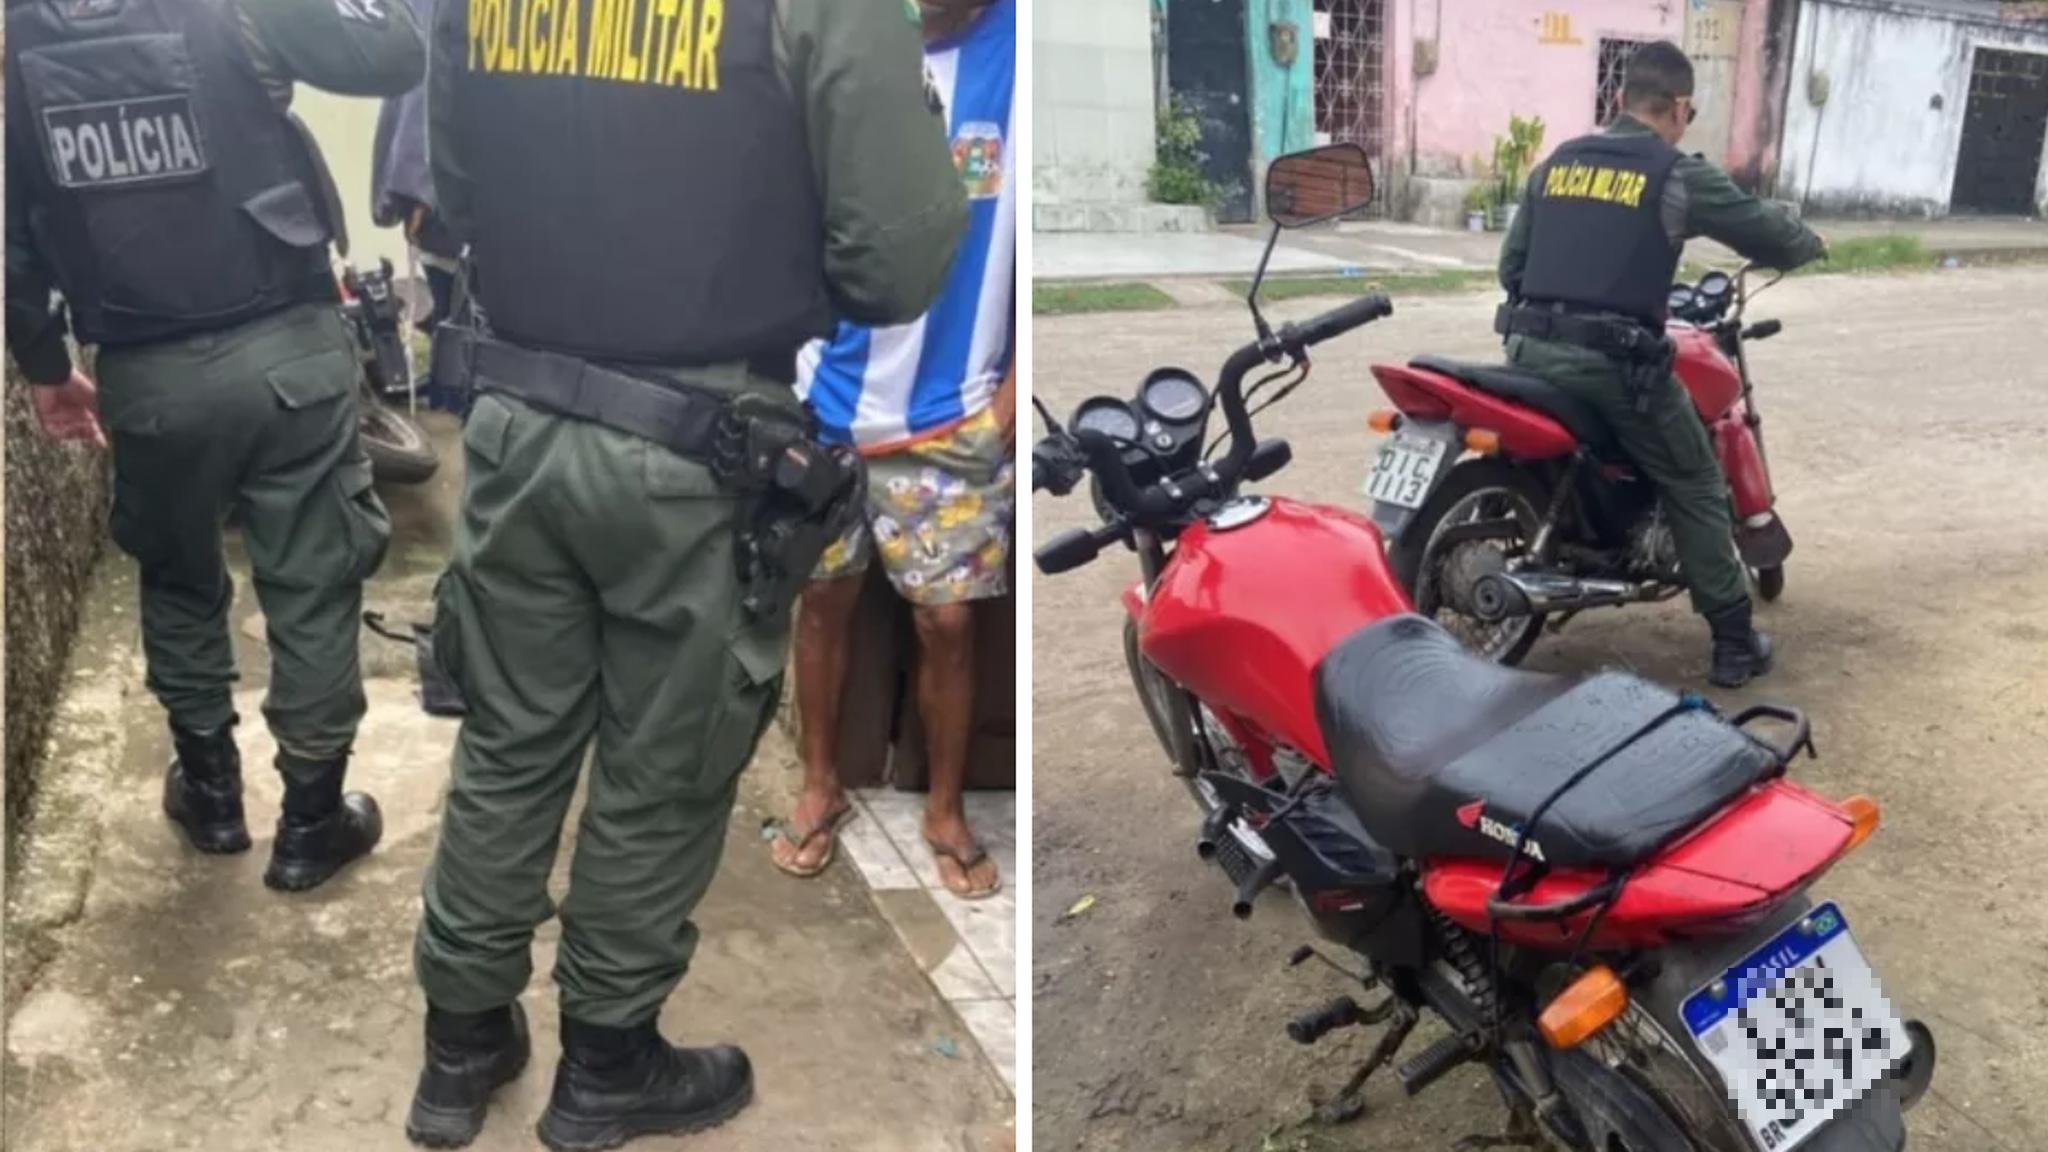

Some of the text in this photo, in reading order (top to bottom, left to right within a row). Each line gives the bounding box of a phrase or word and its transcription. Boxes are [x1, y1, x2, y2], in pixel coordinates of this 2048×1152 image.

[585, 0, 723, 90] MILITAR
[52, 105, 198, 181] POLÍCIA
[1589, 168, 1646, 207] MILITAR
